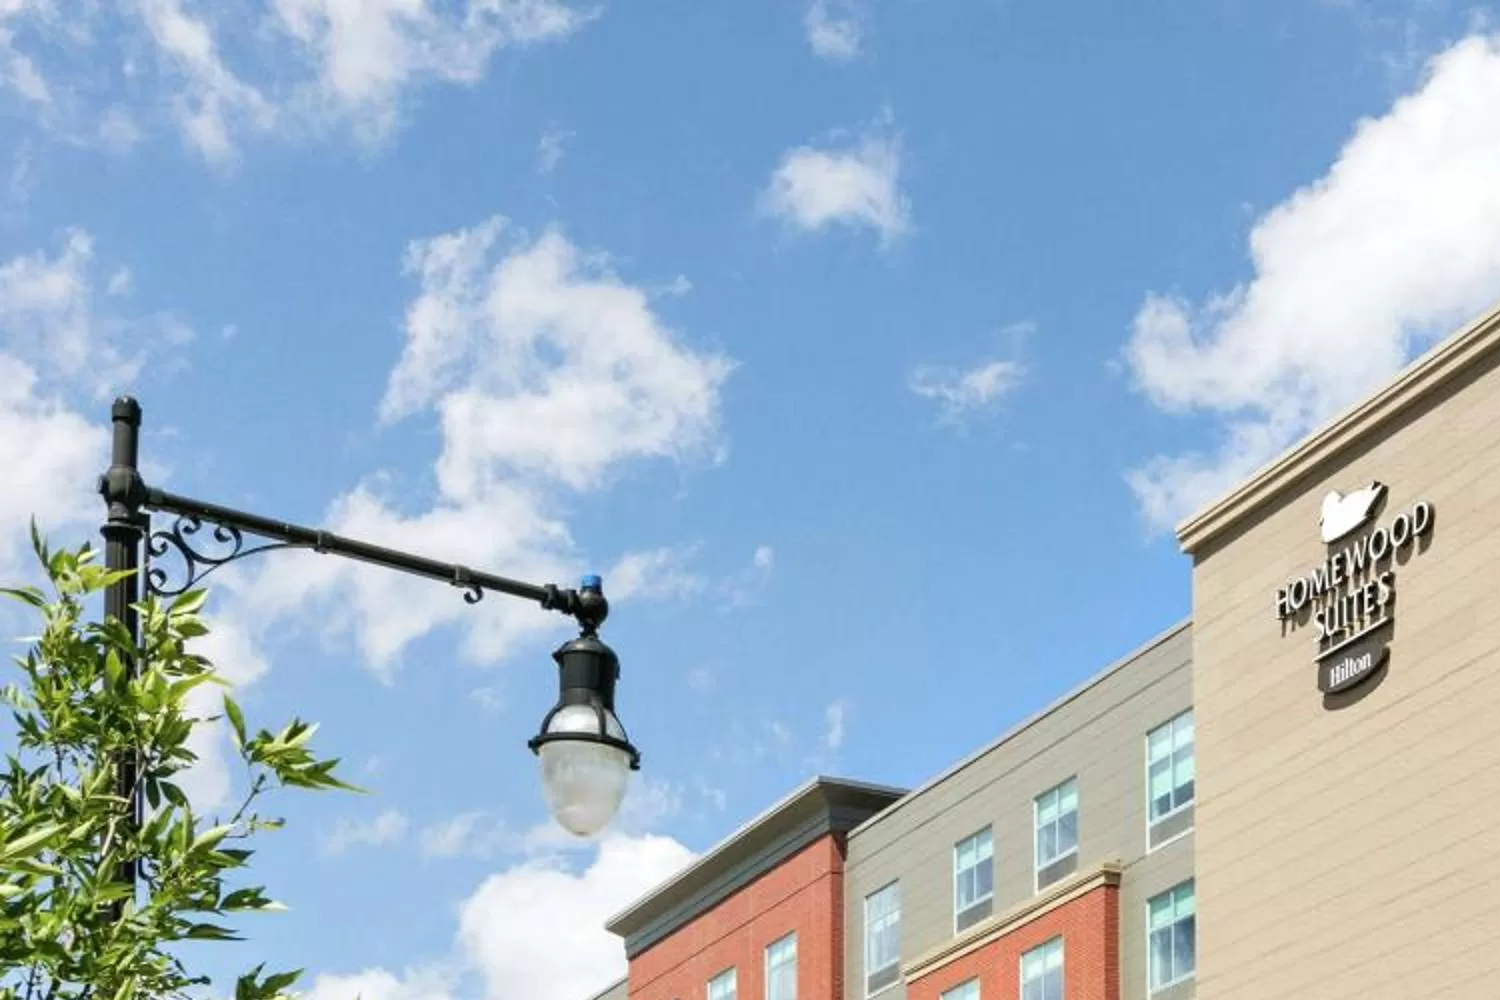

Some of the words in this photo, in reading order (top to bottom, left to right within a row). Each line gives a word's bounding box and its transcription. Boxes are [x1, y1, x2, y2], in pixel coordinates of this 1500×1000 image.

[1276, 501, 1430, 618] HOMEWOOD
[1313, 571, 1391, 643] SUITES
[1329, 652, 1372, 688] Hilton
